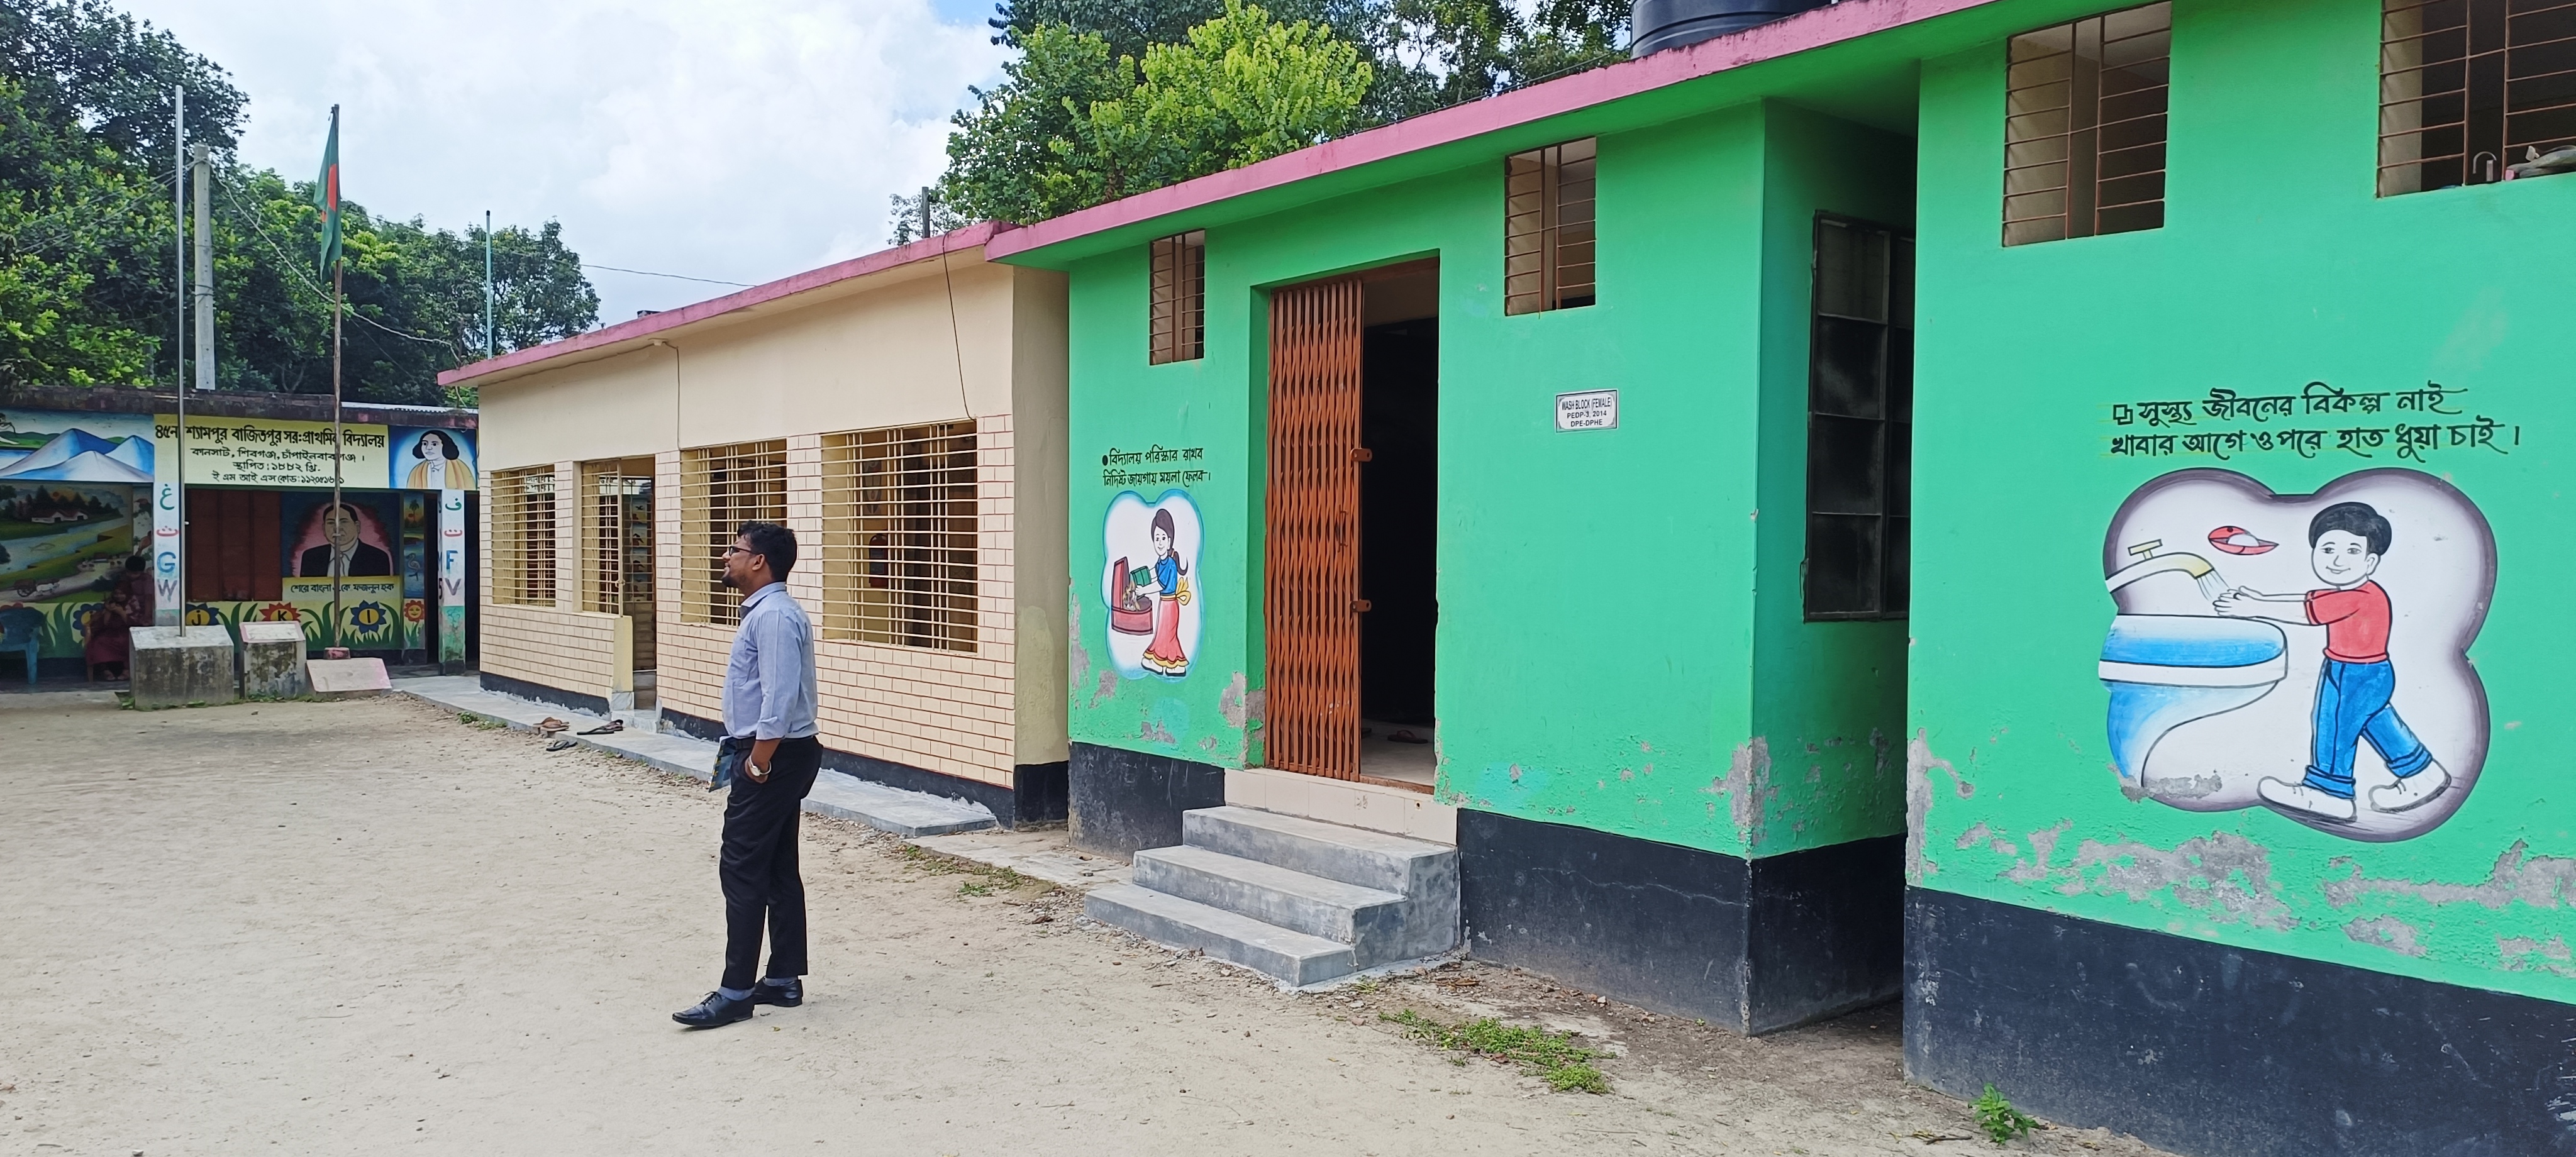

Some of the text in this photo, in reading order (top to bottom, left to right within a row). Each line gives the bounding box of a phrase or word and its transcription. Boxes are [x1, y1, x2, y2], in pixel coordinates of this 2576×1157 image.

[1562, 397, 1612, 411] WASH BLOCK (FEMALE)
[2202, 387, 2296, 423] জীবনের
[2301, 381, 2390, 414] বিকল্প
[2395, 380, 2468, 415] নাই
[1570, 419, 1602, 427] DPE-DPHE
[185, 425, 228, 445] শ্যামপুর
[231, 424, 282, 446] বাজিতপুর
[343, 429, 385, 448] বিদ্যালয়
[2110, 434, 2179, 457] খাবার
[2182, 429, 2247, 460] আগে
[2250, 431, 2274, 450] ও
[2276, 429, 2328, 458] পরে
[2336, 427, 2390, 458] হাত
[1109, 447, 1142, 466] বিদ্যালয়
[1182, 448, 1203, 461] রাখব
[212, 470, 219, 482] ই
[239, 472, 258, 484] আই
[1128, 472, 1157, 487] জায়গায়
[1160, 470, 1180, 484] ময়লা
[159, 484, 175, 510] غ
[445, 497, 462, 511] ف
[156, 526, 179, 537] ث
[157, 551, 176, 573] G
[446, 550, 458, 570] F
[157, 579, 177, 597] W
[291, 584, 309, 592] শেরে
[311, 584, 331, 593] বাংলা
[445, 578, 462, 595] V
